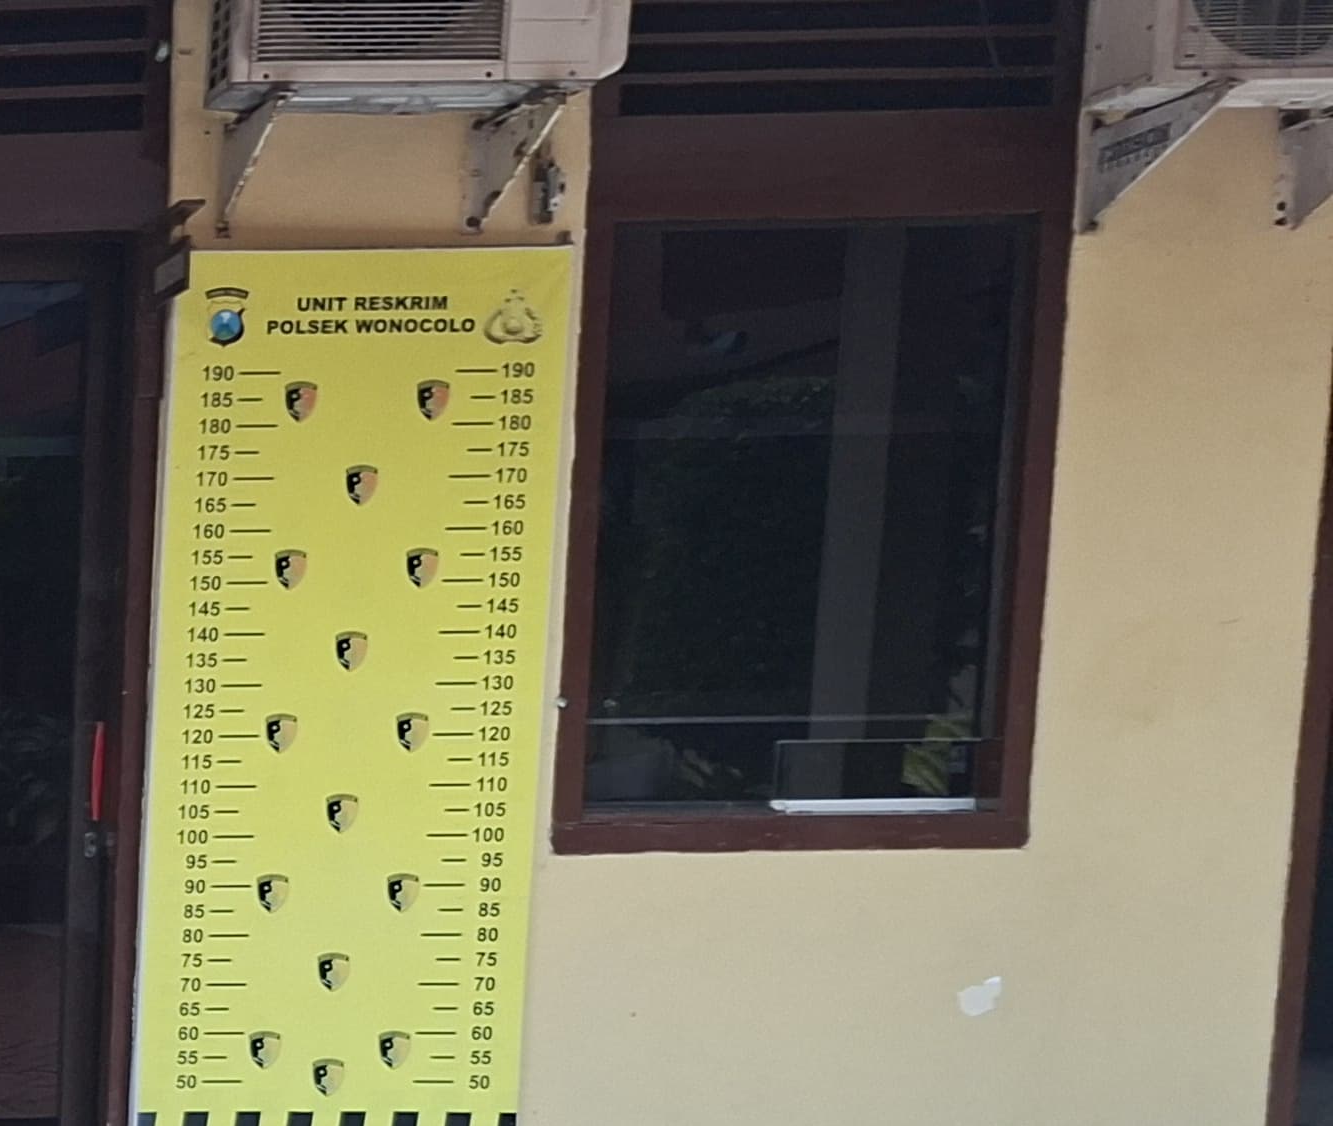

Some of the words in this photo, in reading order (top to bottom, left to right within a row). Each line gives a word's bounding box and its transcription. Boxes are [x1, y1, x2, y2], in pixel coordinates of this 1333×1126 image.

[296, 296, 347, 312] UNIT
[354, 295, 448, 311] RESKRIM
[266, 319, 348, 335] POLSEK
[355, 318, 476, 334] WONOCOLO
[203, 365, 235, 382] 190
[502, 362, 535, 378] 190
[201, 391, 233, 408] 185
[501, 388, 534, 404] 185
[200, 418, 231, 434] 180
[499, 415, 531, 431] 180
[198, 444, 230, 461] 175
[498, 441, 529, 457] 175
[197, 471, 228, 487] 170
[496, 467, 527, 483] 170
[195, 497, 227, 513] 165
[494, 494, 526, 510] 165
[194, 523, 225, 539] 160
[492, 520, 524, 536] 160
[192, 549, 223, 565] 155
[490, 546, 522, 562] 155
[190, 575, 222, 591] 150
[488, 572, 521, 588] 150
[190, 601, 220, 617] 145
[487, 598, 519, 613] 145
[188, 627, 219, 642] 140
[486, 623, 517, 639] 140
[186, 652, 218, 668] 135
[484, 649, 516, 665] 135
[185, 678, 216, 694] 130
[482, 675, 514, 691] 130
[184, 703, 215, 719] 125
[481, 700, 512, 716] 125
[182, 729, 213, 745] 120
[479, 726, 511, 742] 120
[183, 754, 212, 769] 115
[479, 751, 509, 767] 115
[182, 779, 211, 794] 110
[477, 776, 508, 792] 110
[179, 804, 210, 820] 105
[475, 802, 506, 817] 105
[178, 829, 208, 845] 100
[473, 827, 505, 842] 100
[186, 854, 207, 869] 95
[482, 852, 503, 868] 95
[185, 879, 206, 894] 90
[480, 877, 502, 893] 90
[183, 903, 205, 919] 85
[478, 902, 500, 917] 85
[182, 928, 204, 944] 80
[477, 927, 499, 942] 80
[181, 953, 203, 968] 75
[476, 951, 497, 967] 75
[180, 977, 201, 992] 70
[474, 976, 496, 991] 70
[179, 1002, 200, 1017] 65
[473, 1001, 494, 1016] 65
[178, 1026, 199, 1041] 60
[471, 1025, 493, 1041] 60
[177, 1050, 198, 1065] 55
[470, 1050, 492, 1065] 55
[176, 1074, 197, 1089] 50
[469, 1074, 490, 1090] 50
